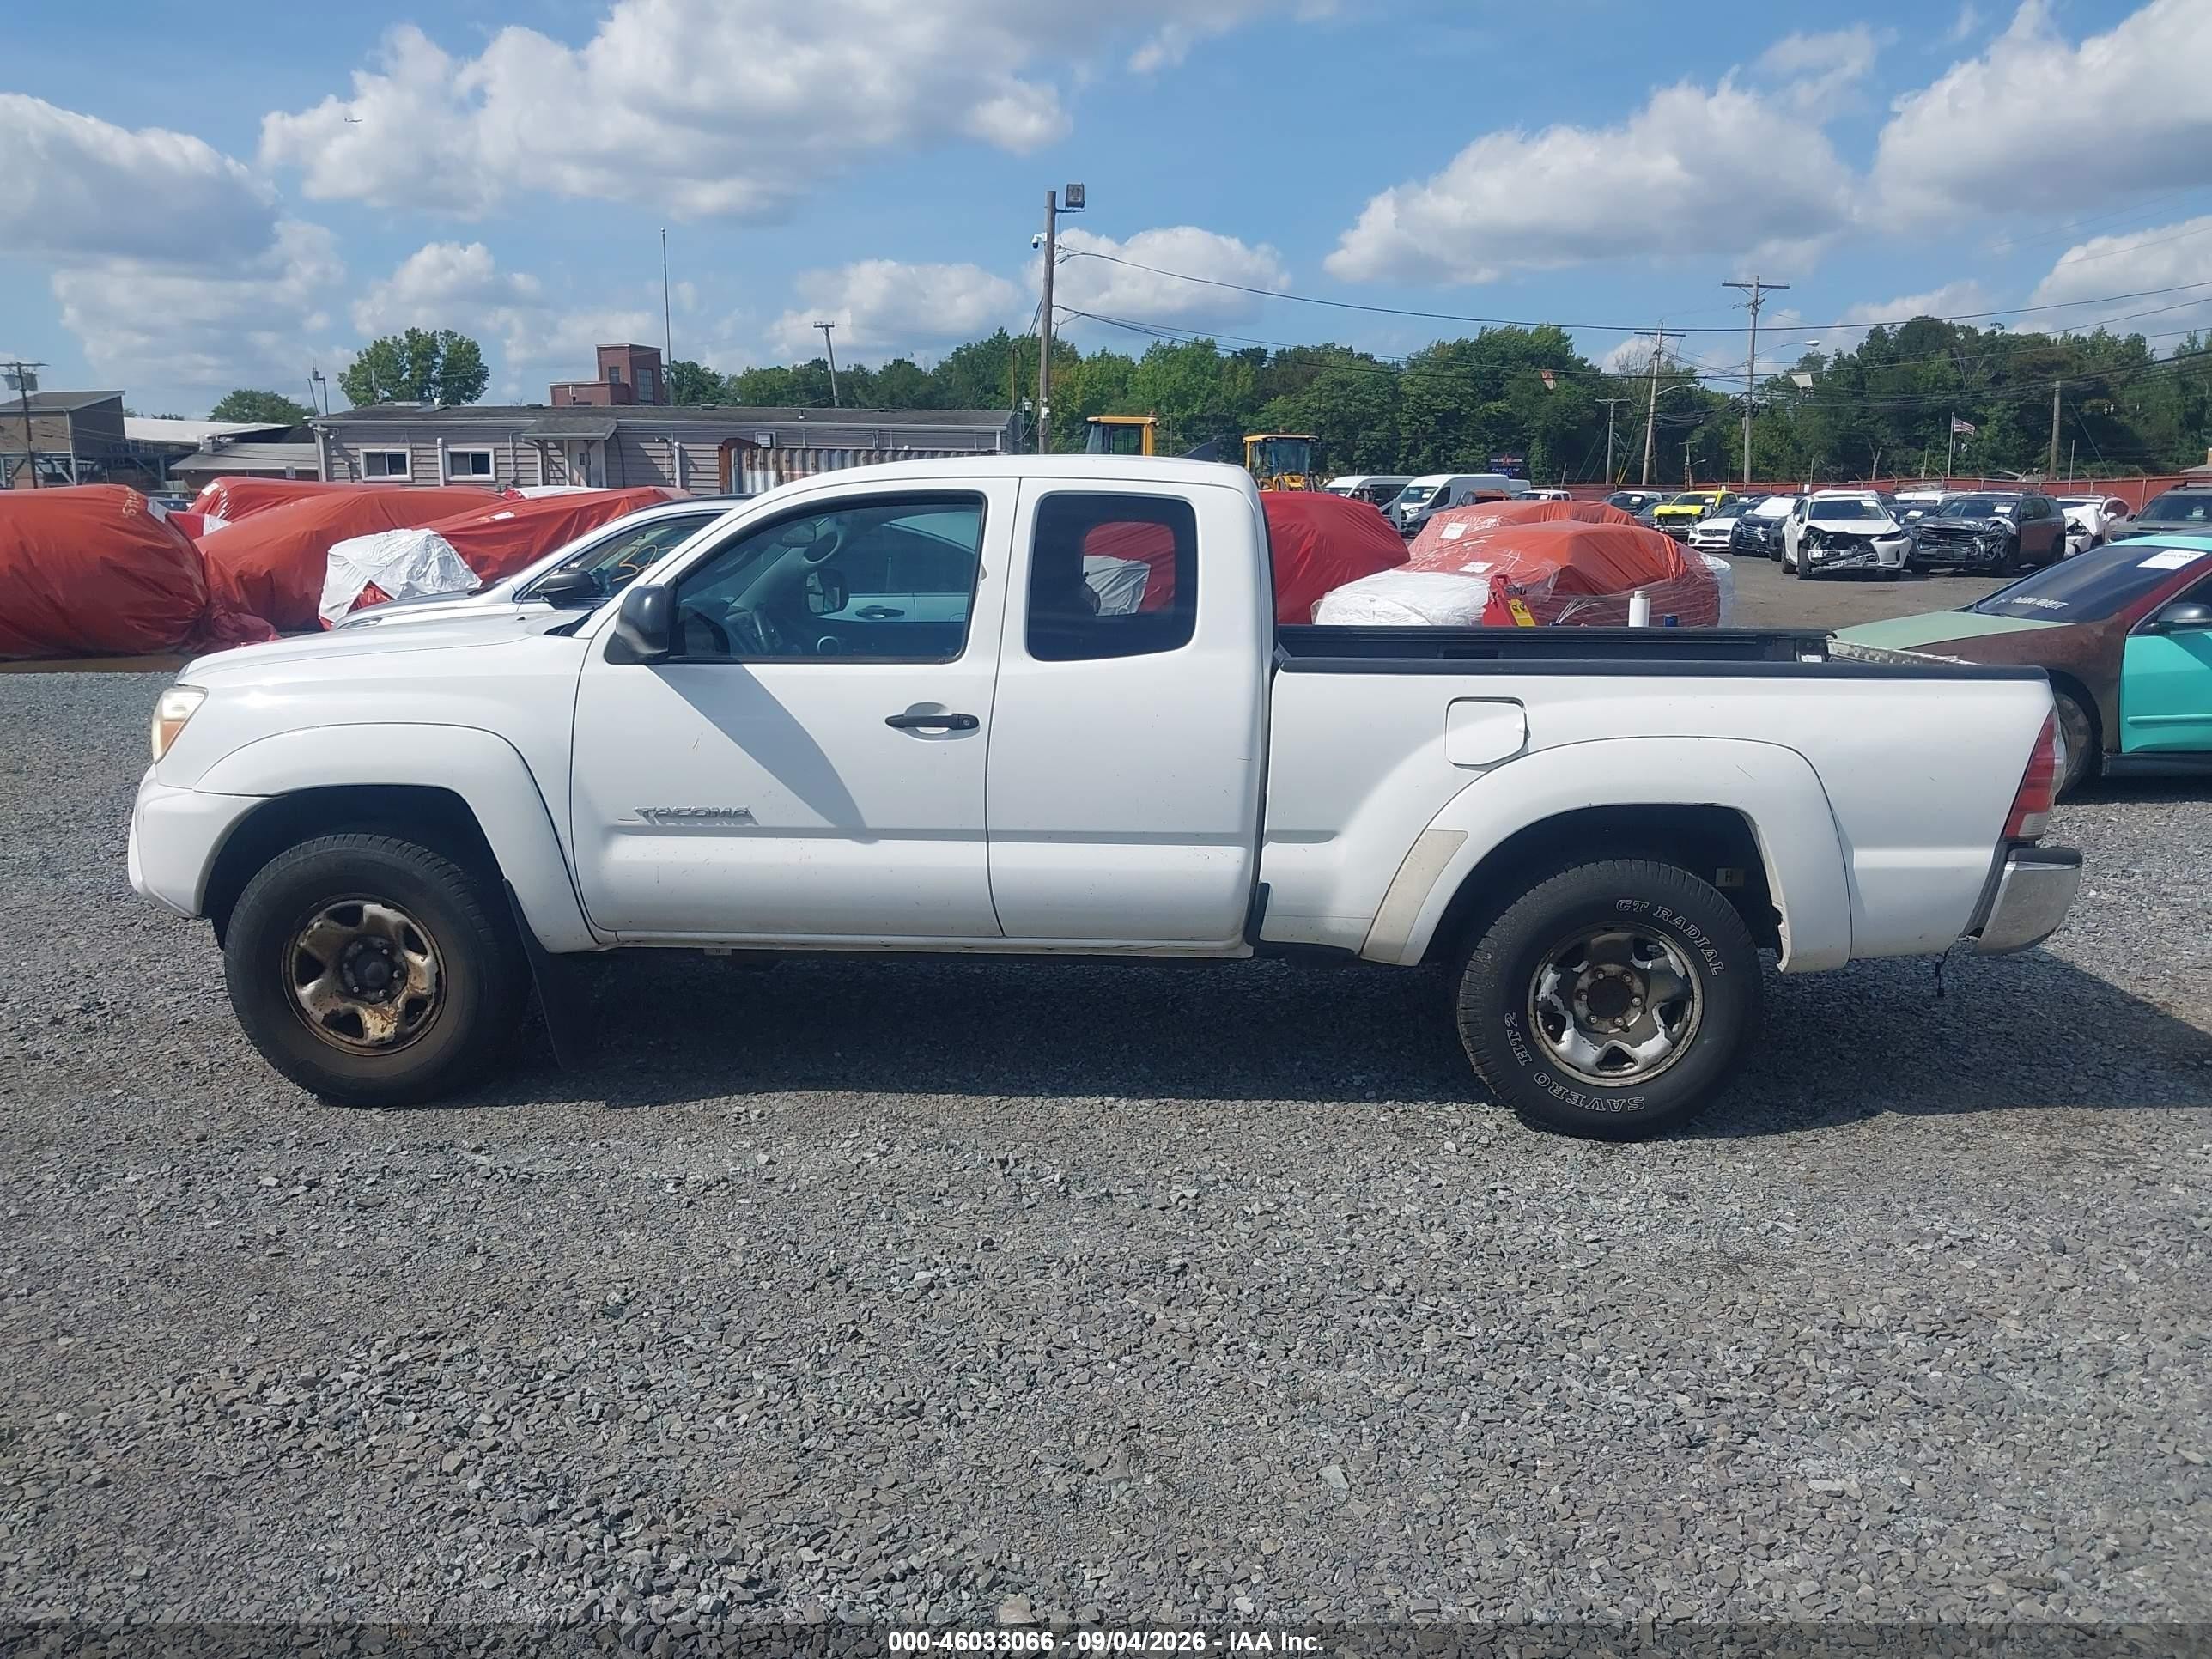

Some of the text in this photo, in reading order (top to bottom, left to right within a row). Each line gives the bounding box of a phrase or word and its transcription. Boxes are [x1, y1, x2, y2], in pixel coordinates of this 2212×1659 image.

[1615, 899, 1726, 977] GT RADIAL
[1504, 1011, 1646, 1113] SAVERO HT2
